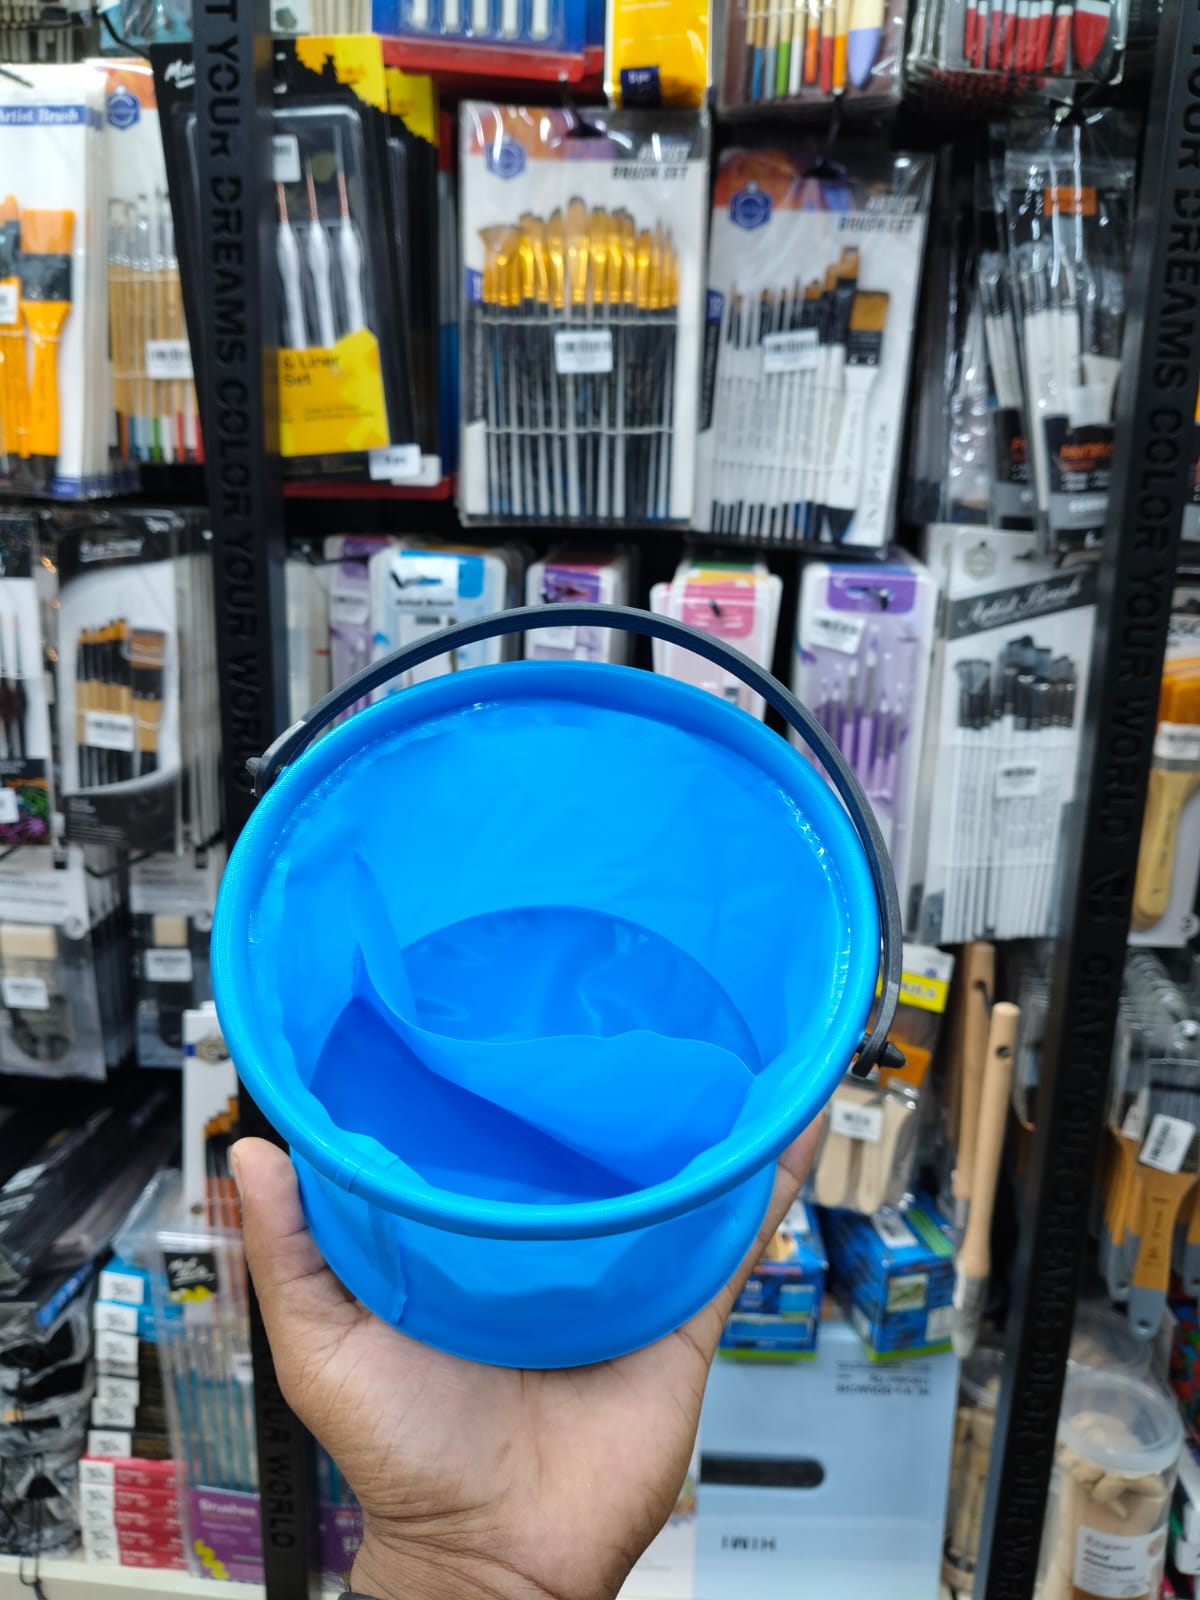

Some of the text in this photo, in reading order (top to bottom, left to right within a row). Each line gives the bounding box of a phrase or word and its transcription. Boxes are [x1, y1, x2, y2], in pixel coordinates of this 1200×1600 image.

[206, 34, 241, 157] YOUR
[210, 175, 248, 364] DREAMS
[1153, 187, 1200, 390] DREAMS
[217, 378, 253, 519] COLOR
[1134, 407, 1183, 550] COLOR
[223, 531, 259, 638] YOUR
[1118, 567, 1164, 680] YOUR
[1100, 696, 1148, 838] WORLD
[260, 1376, 297, 1549] OUR WORLD
[995, 1536, 1032, 1600] WOR
